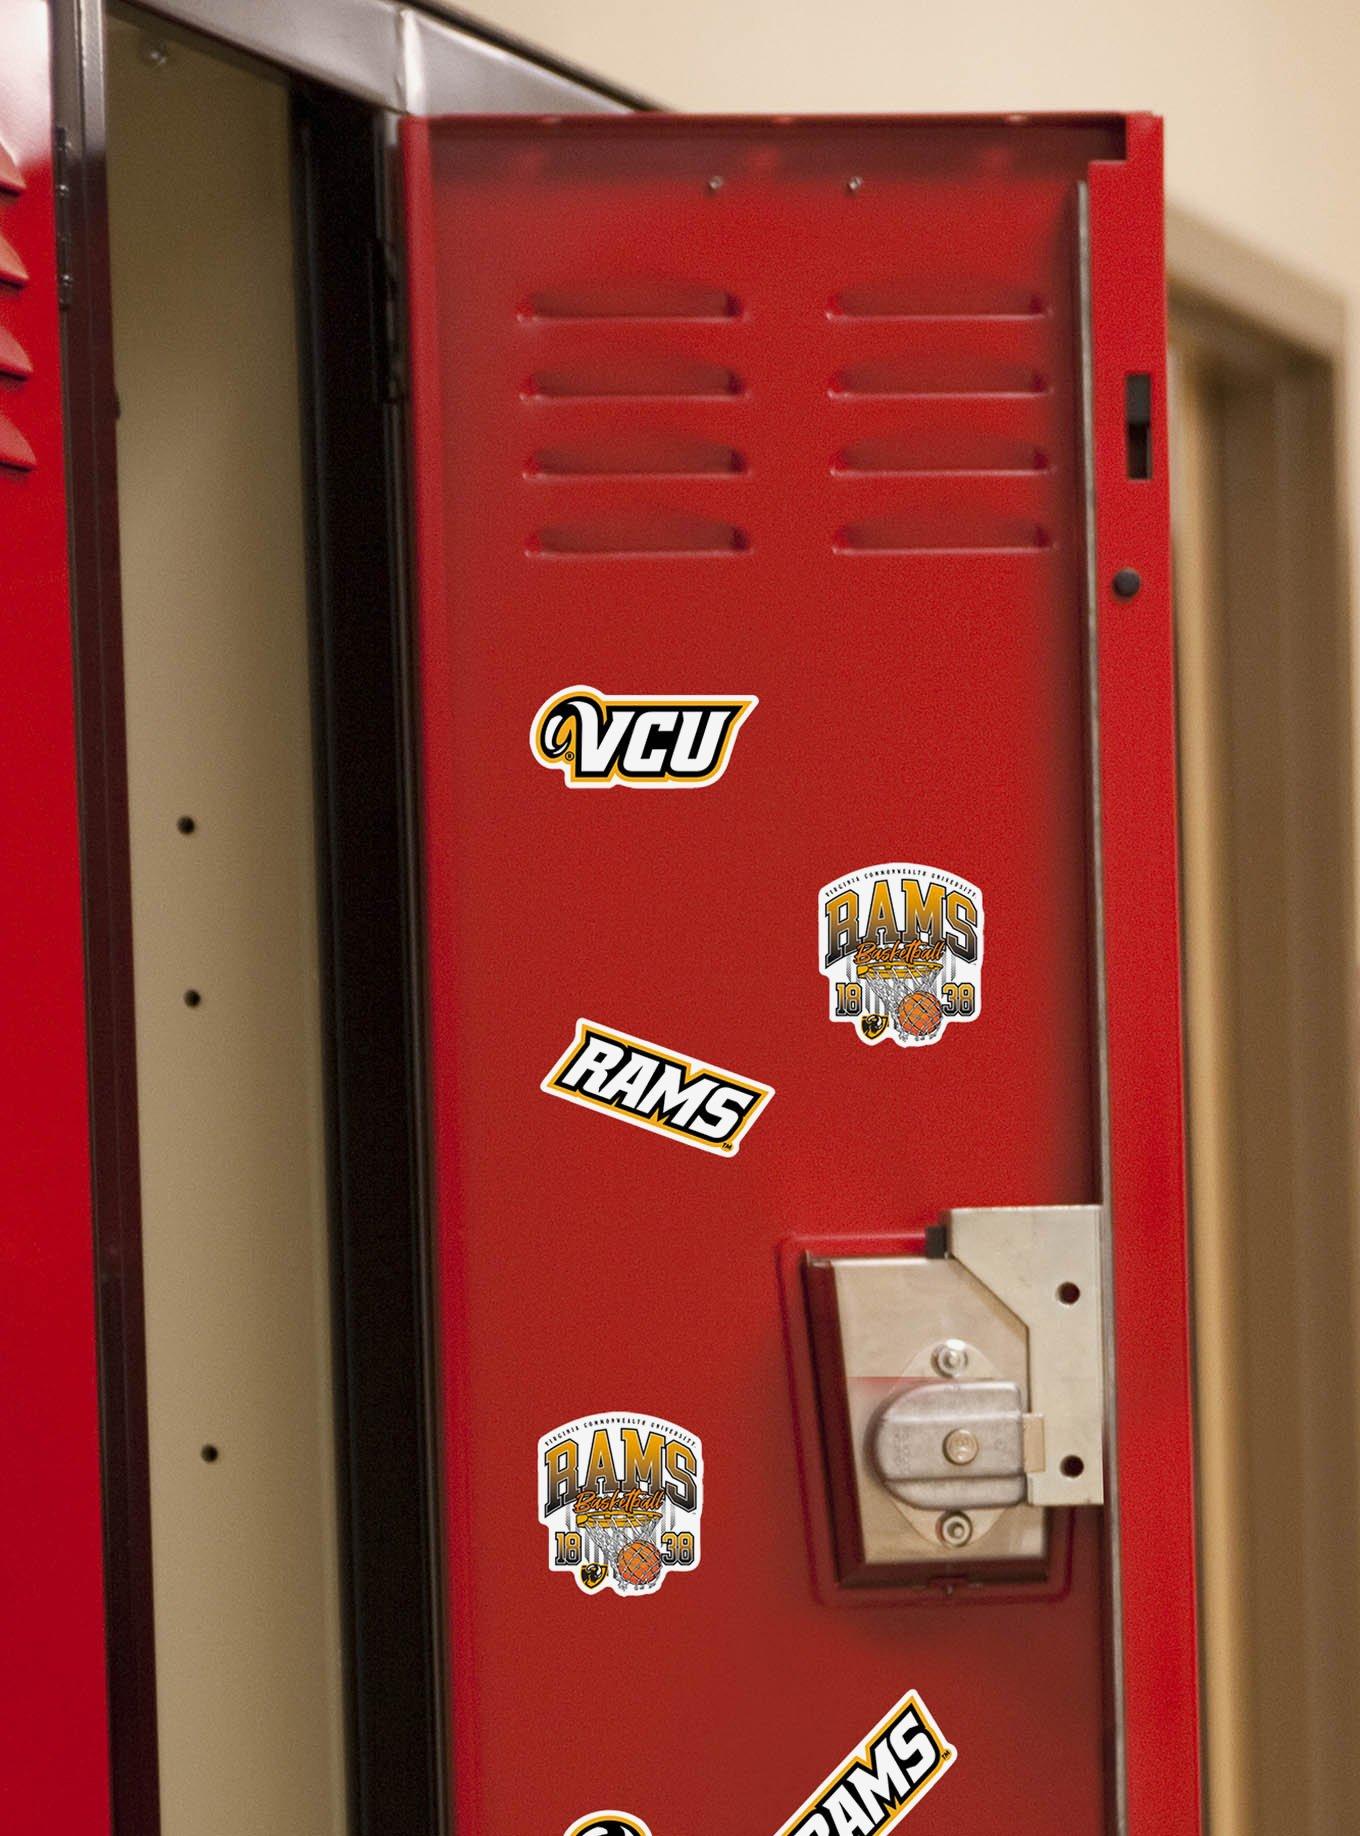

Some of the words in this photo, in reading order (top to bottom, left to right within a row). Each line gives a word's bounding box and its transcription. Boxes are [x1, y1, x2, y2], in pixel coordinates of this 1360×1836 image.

[569, 701, 735, 774] VCU
[825, 879, 978, 968] RAMS
[853, 940, 945, 965] Basketball
[835, 982, 862, 1017] 18
[942, 982, 976, 1017] 38
[560, 1034, 757, 1141] RAMS
[544, 1428, 697, 1518] RAMS
[572, 1489, 665, 1514] Basketball
[554, 1531, 582, 1566] 18
[660, 1531, 695, 1566] 38
